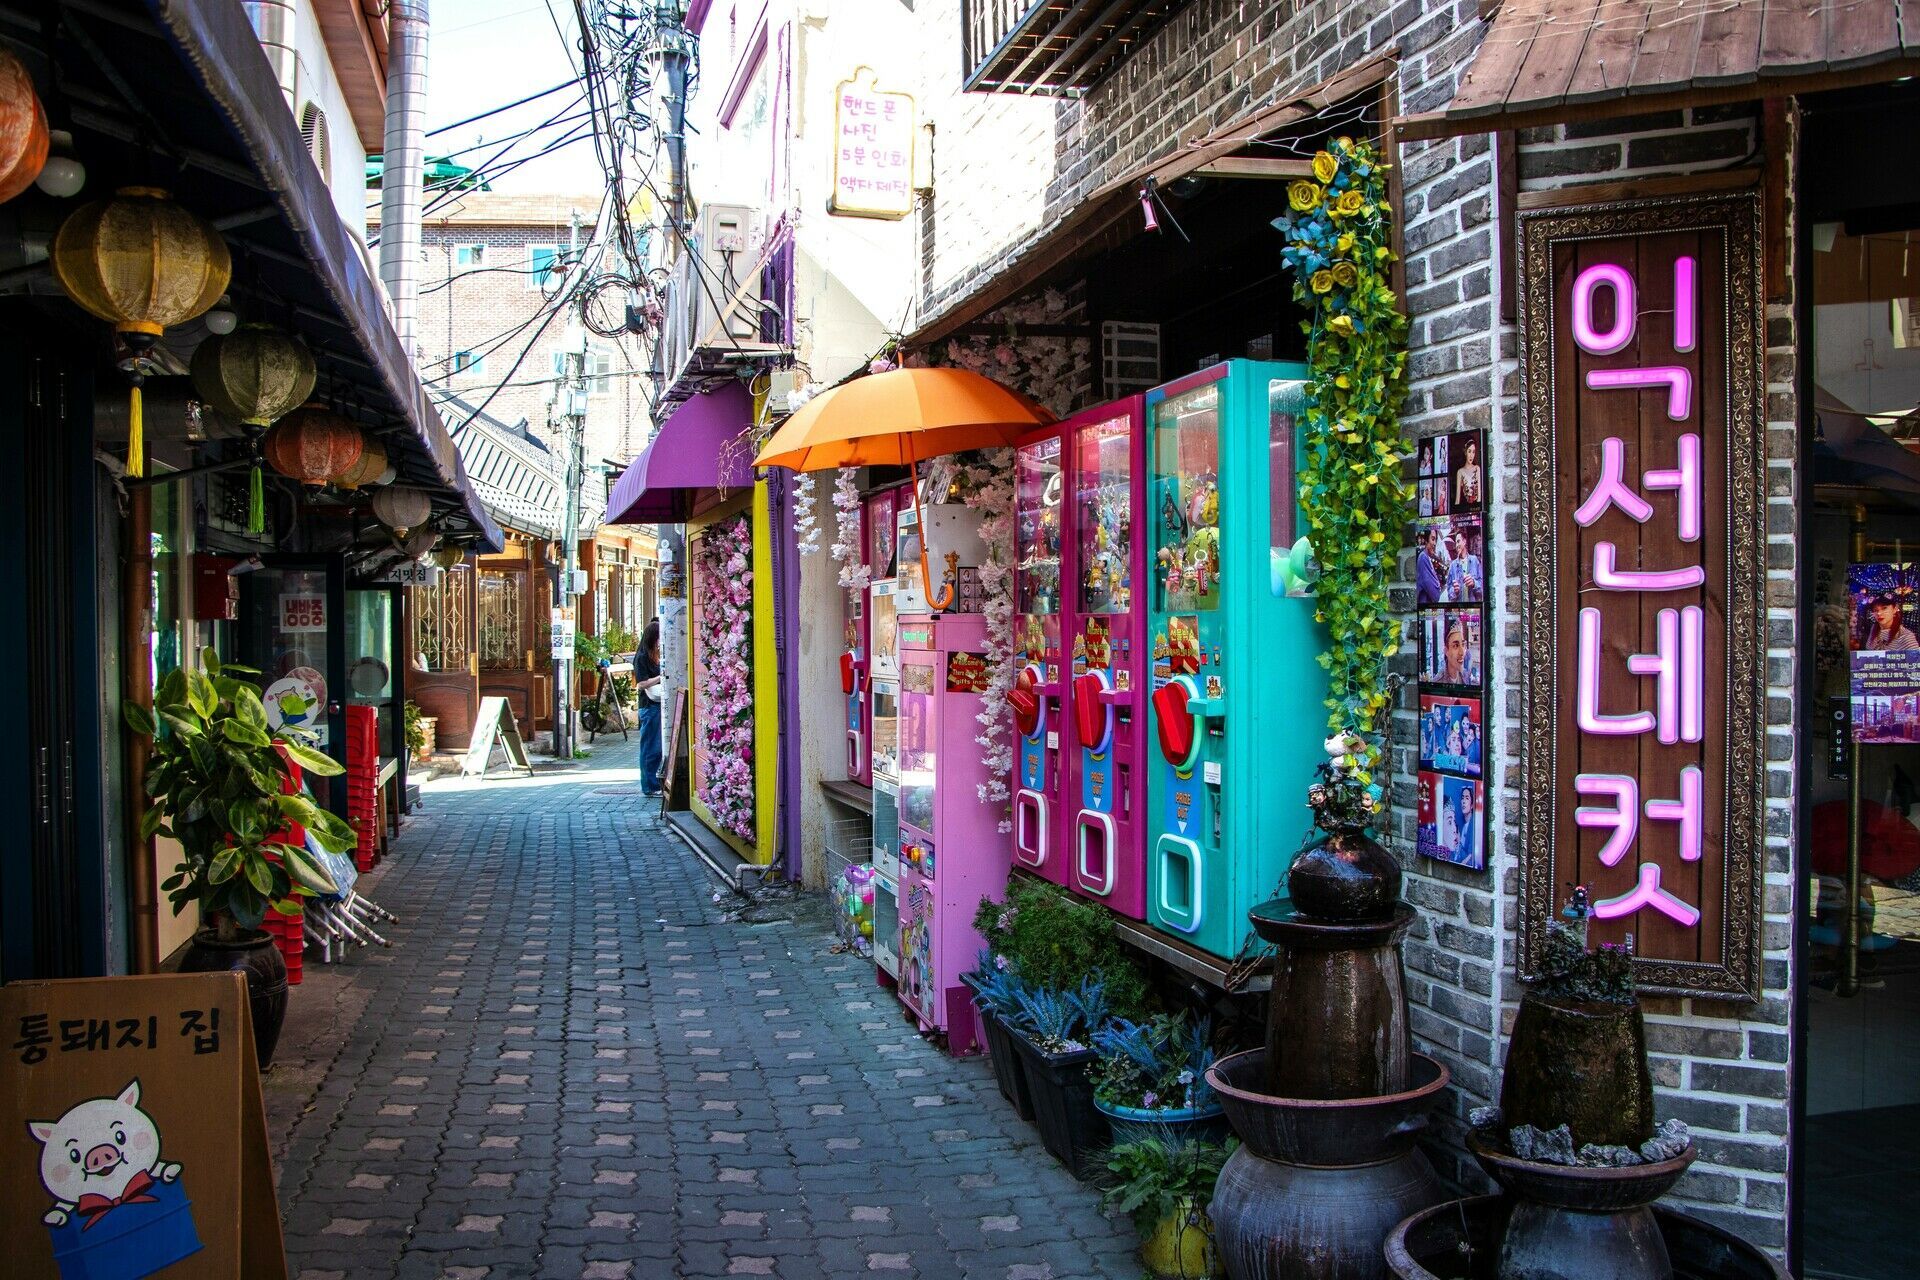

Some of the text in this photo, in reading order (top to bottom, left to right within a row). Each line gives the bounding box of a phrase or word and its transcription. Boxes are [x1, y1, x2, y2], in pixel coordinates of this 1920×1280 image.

[842, 123, 877, 142] 사진
[839, 175, 909, 198] 액자 제작
[1571, 254, 1706, 928] 익선네컷
[285, 599, 323, 627] 냉방중
[13, 1007, 220, 1065] 통돼지 집
